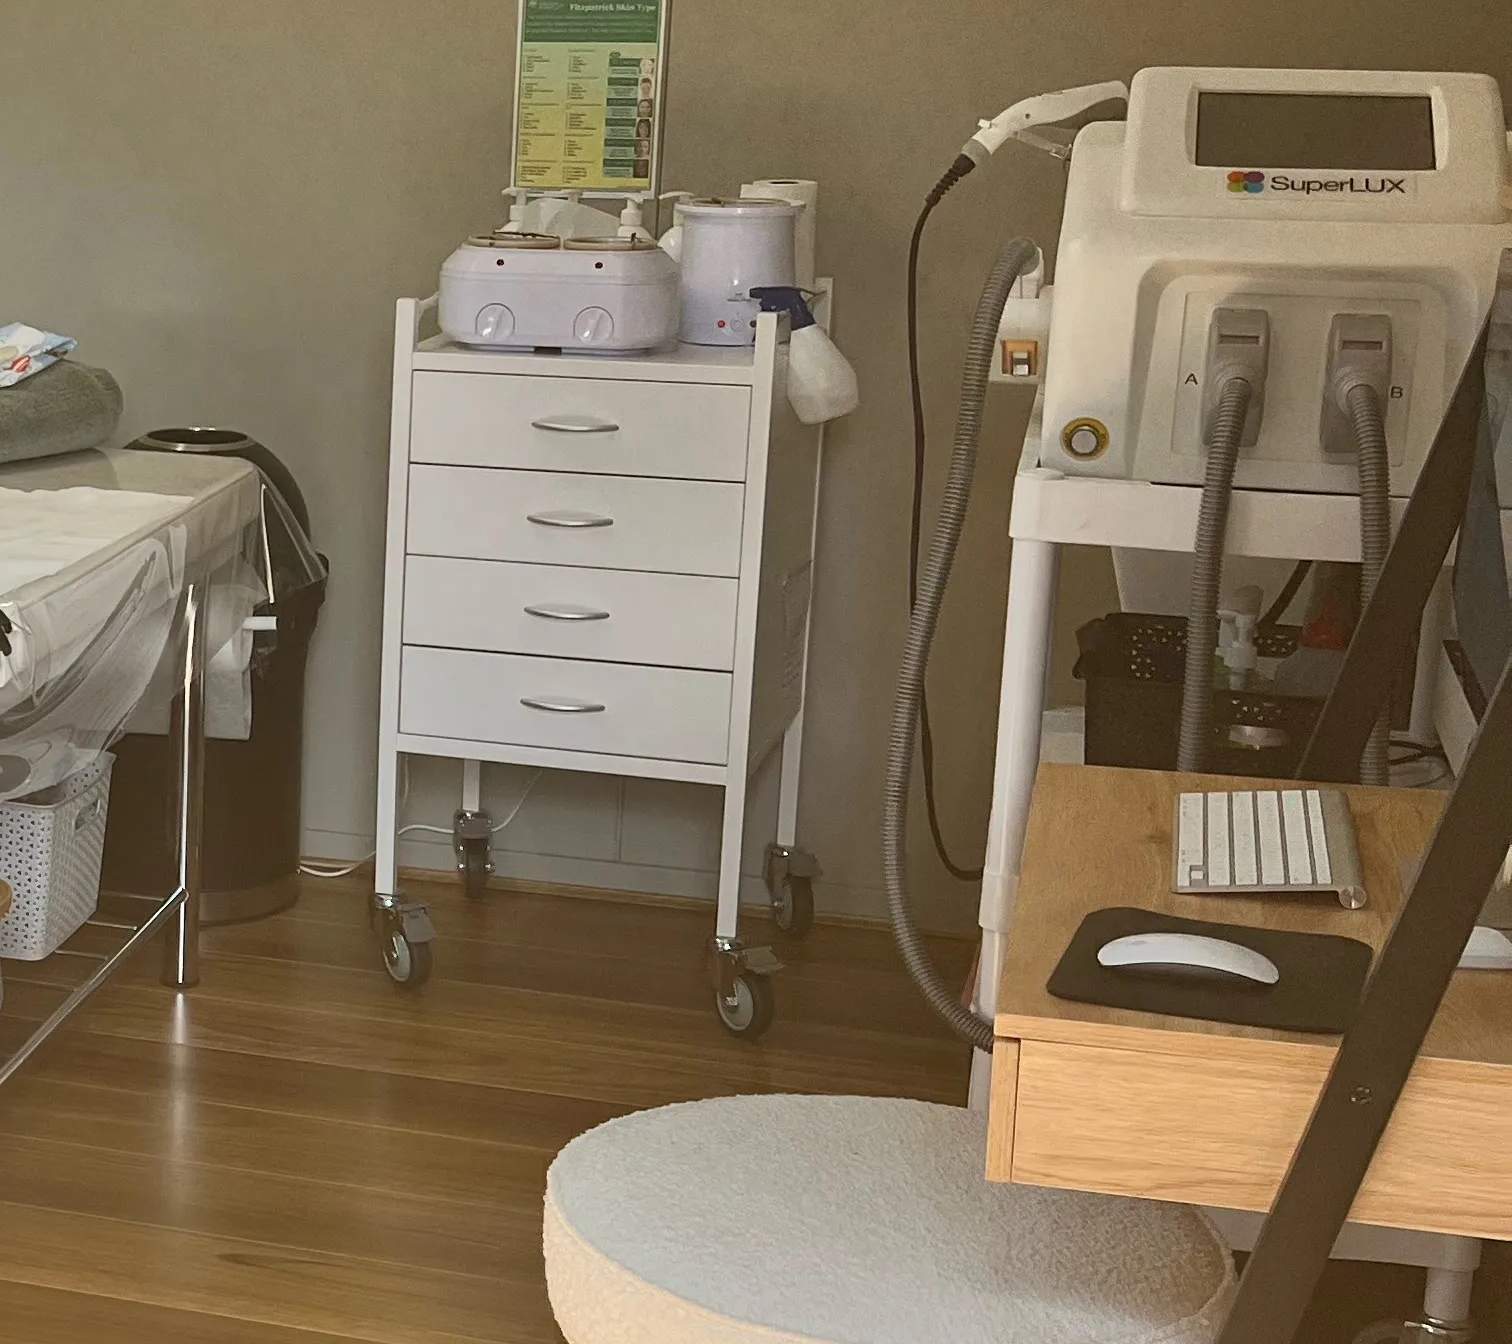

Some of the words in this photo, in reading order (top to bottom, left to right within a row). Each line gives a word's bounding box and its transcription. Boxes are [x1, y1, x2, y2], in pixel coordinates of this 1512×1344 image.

[615, 3, 635, 12] Skin
[637, 3, 656, 13] Type
[1270, 175, 1406, 195] SuperLUX
[1184, 372, 1199, 386] A
[1390, 386, 1404, 399] B
